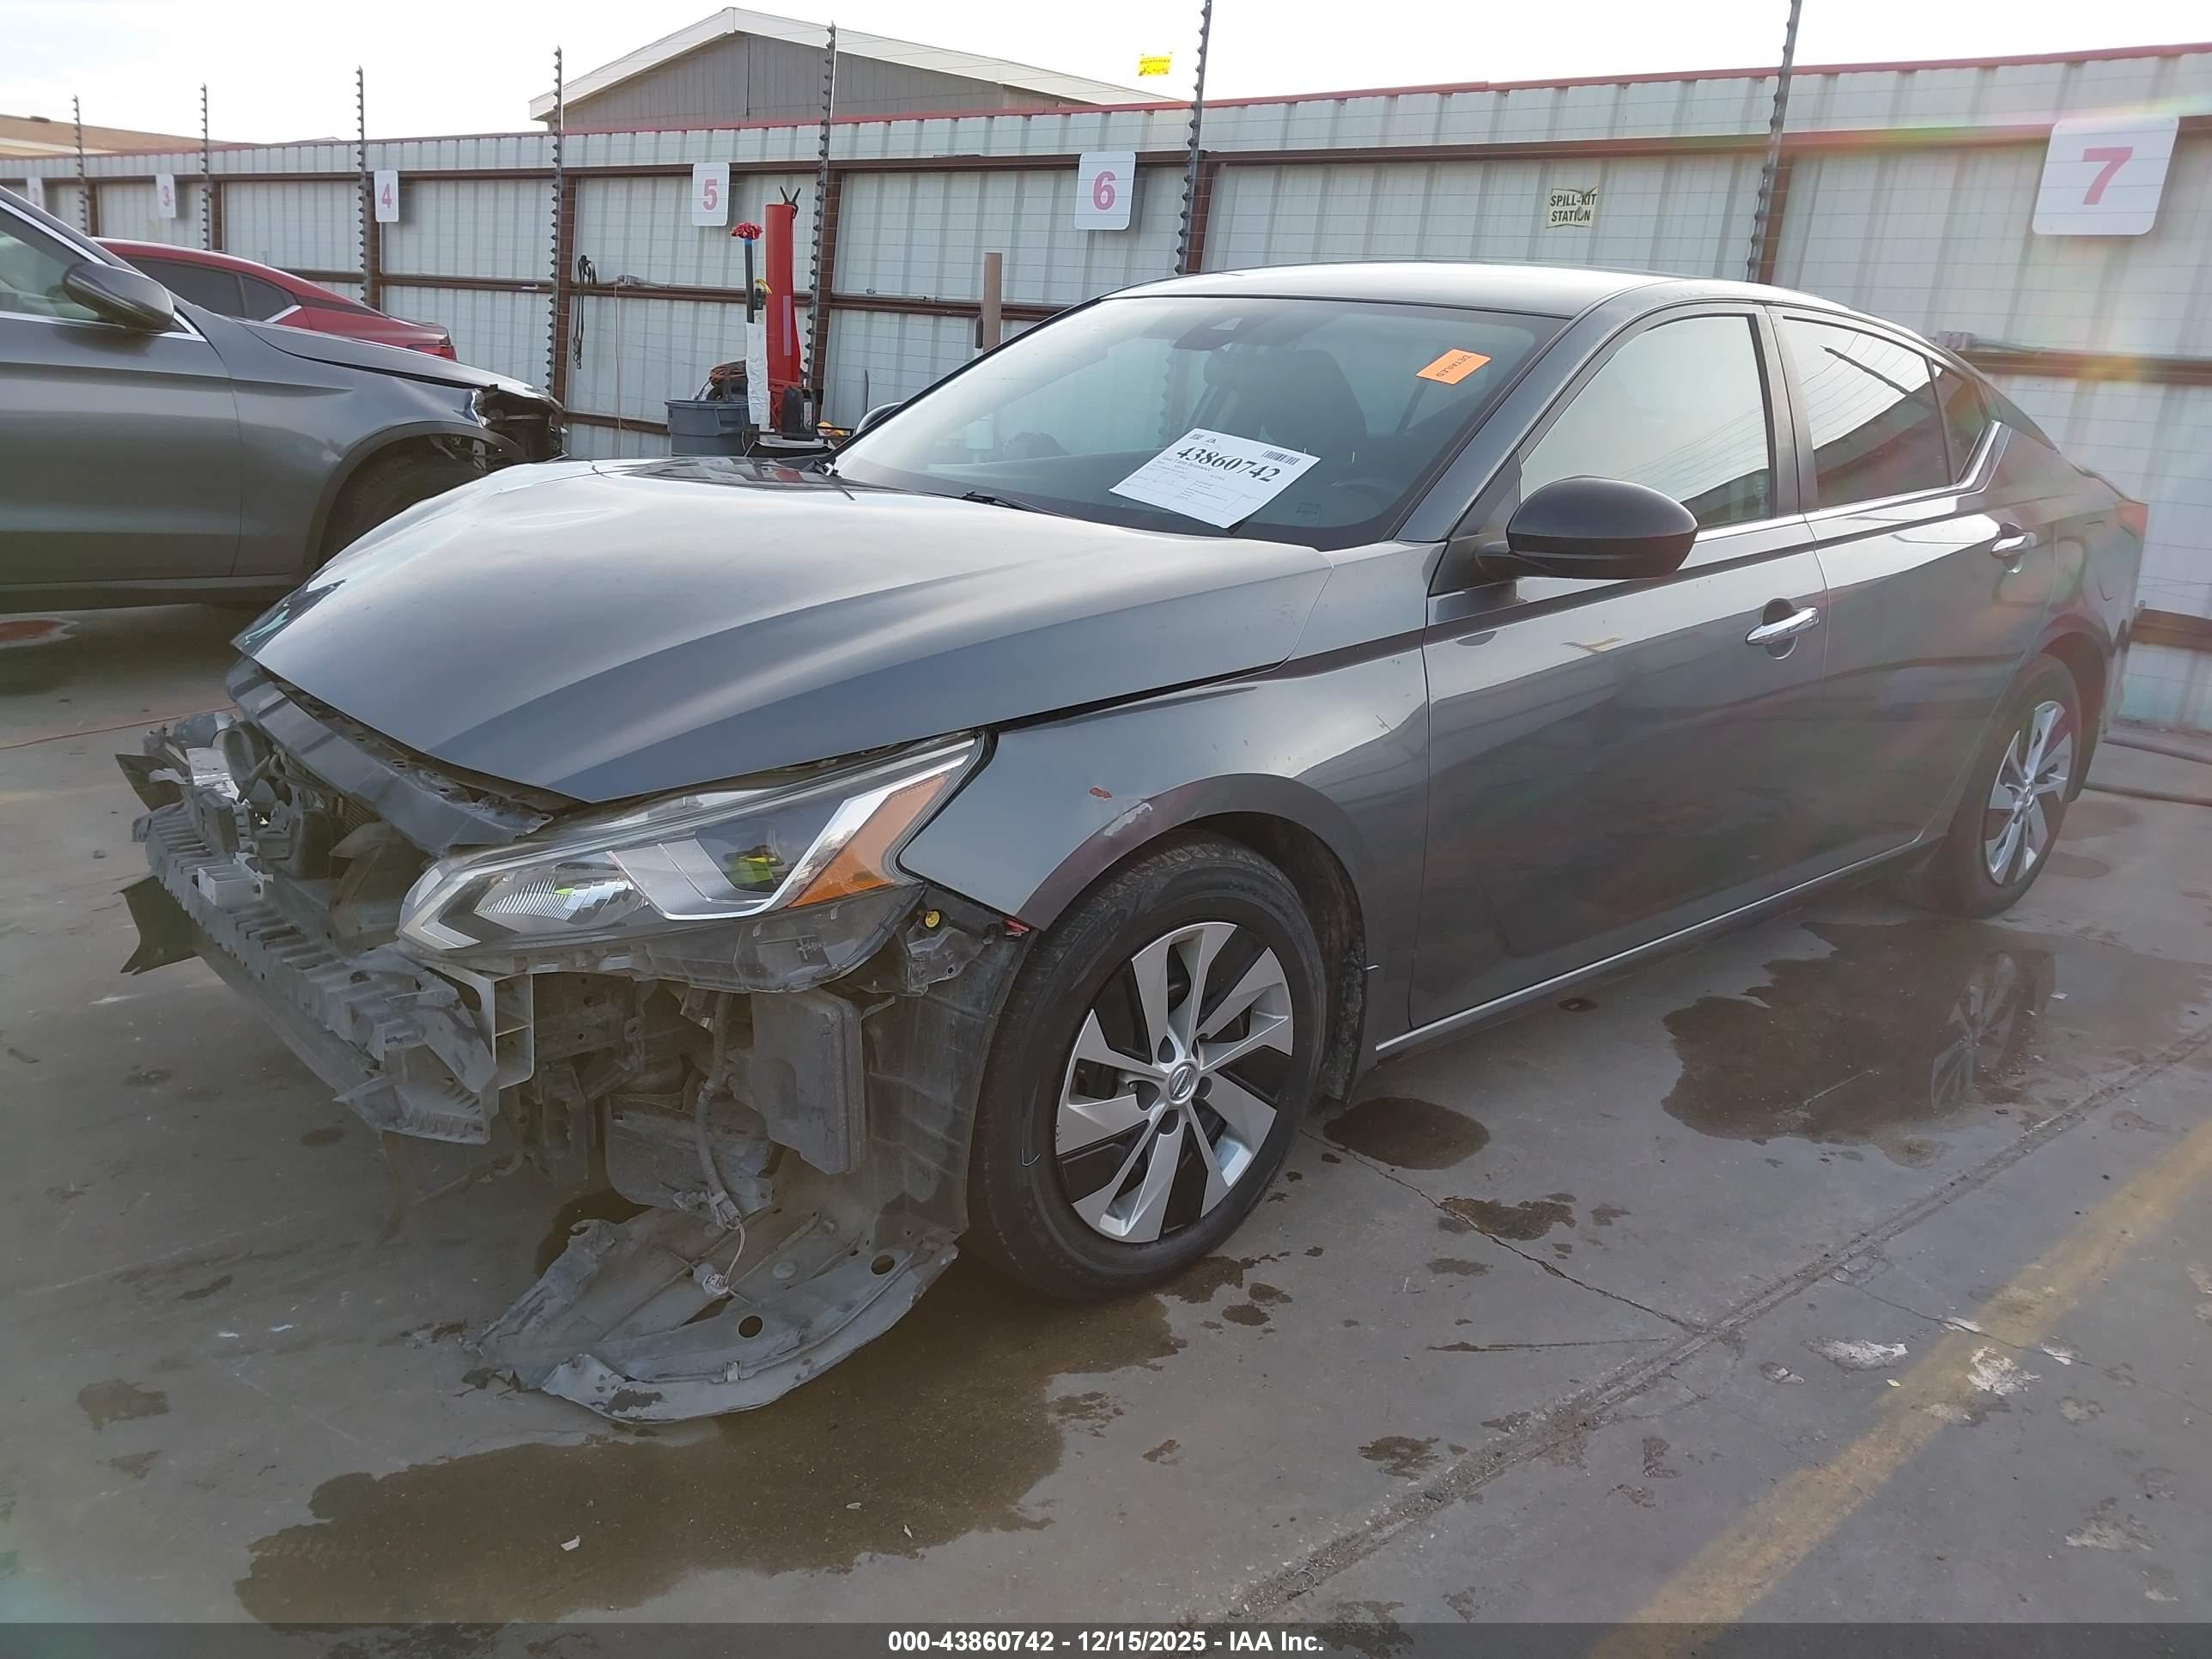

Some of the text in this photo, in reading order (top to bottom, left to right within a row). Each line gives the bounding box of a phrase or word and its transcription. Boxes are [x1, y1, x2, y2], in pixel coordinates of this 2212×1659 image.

[2081, 146, 2134, 205] 7
[162, 185, 171, 207] 3
[382, 183, 392, 209] 4
[703, 179, 718, 210] 5
[1093, 171, 1116, 210] 6
[1551, 193, 1597, 206] SPILL-KIT
[1551, 210, 1591, 222] STATION
[1176, 447, 1280, 483] 43860742
